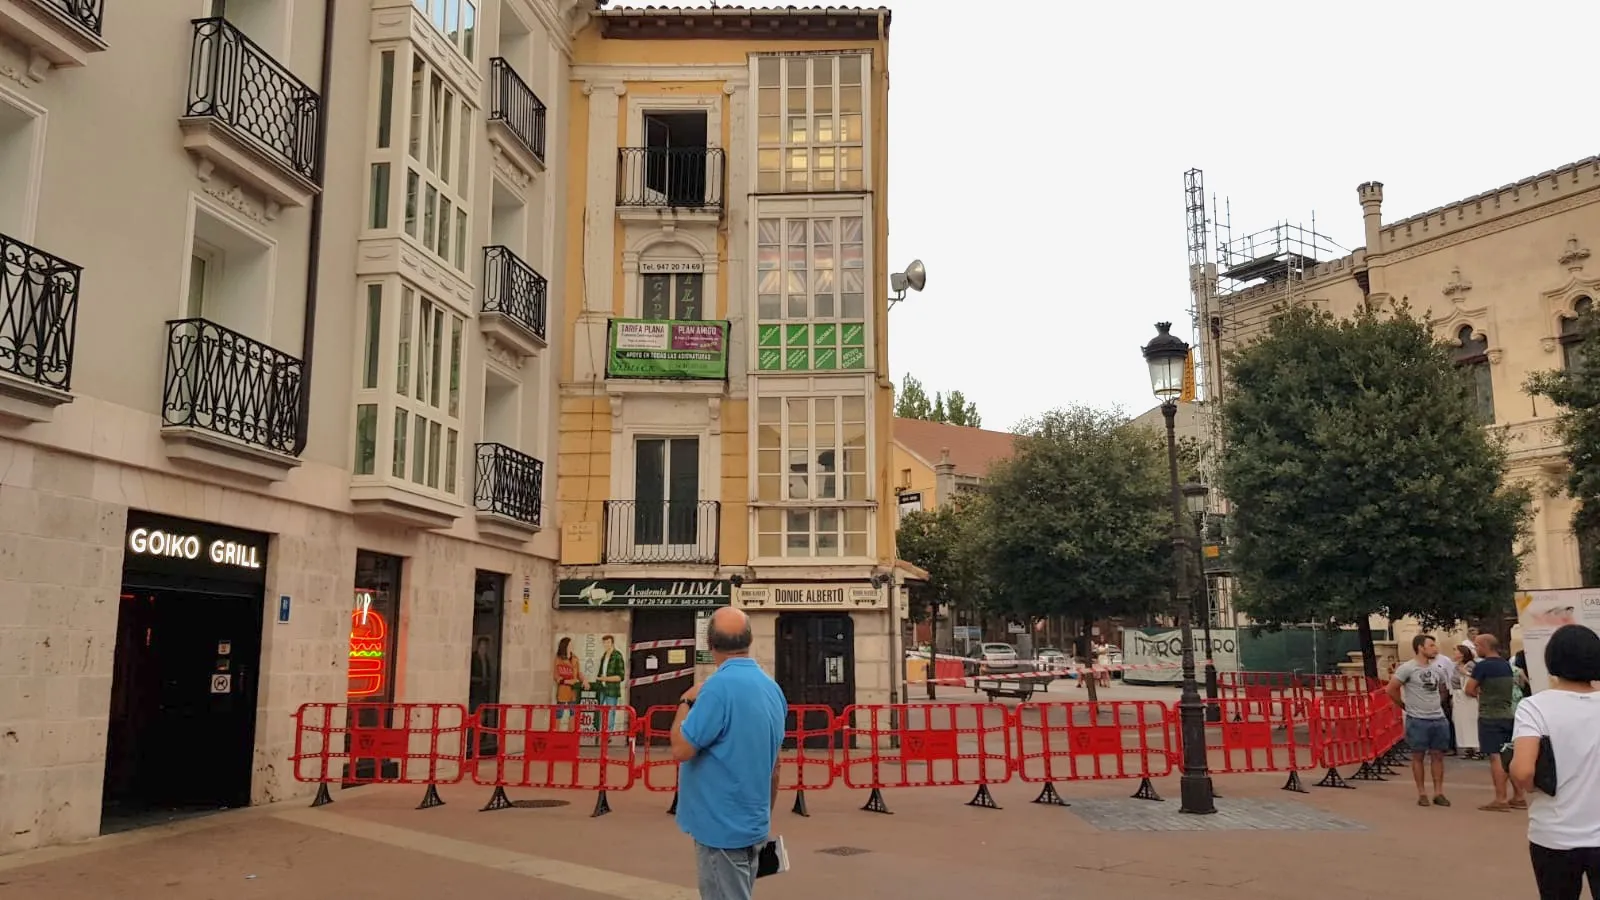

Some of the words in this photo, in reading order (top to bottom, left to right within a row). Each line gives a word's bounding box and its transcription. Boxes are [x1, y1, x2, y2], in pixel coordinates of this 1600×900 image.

[657, 263, 669, 271] 947
[671, 263, 680, 271] 20
[621, 324, 643, 334] TARIFA
[645, 324, 664, 334] PLANA
[678, 325, 695, 335] PLAN
[130, 528, 200, 560] GOIKO
[210, 539, 260, 568] GRILL
[624, 583, 667, 596] Academia
[669, 581, 723, 596] ILIMA
[775, 588, 803, 603] DONDE
[806, 588, 844, 603] ALBERTO
